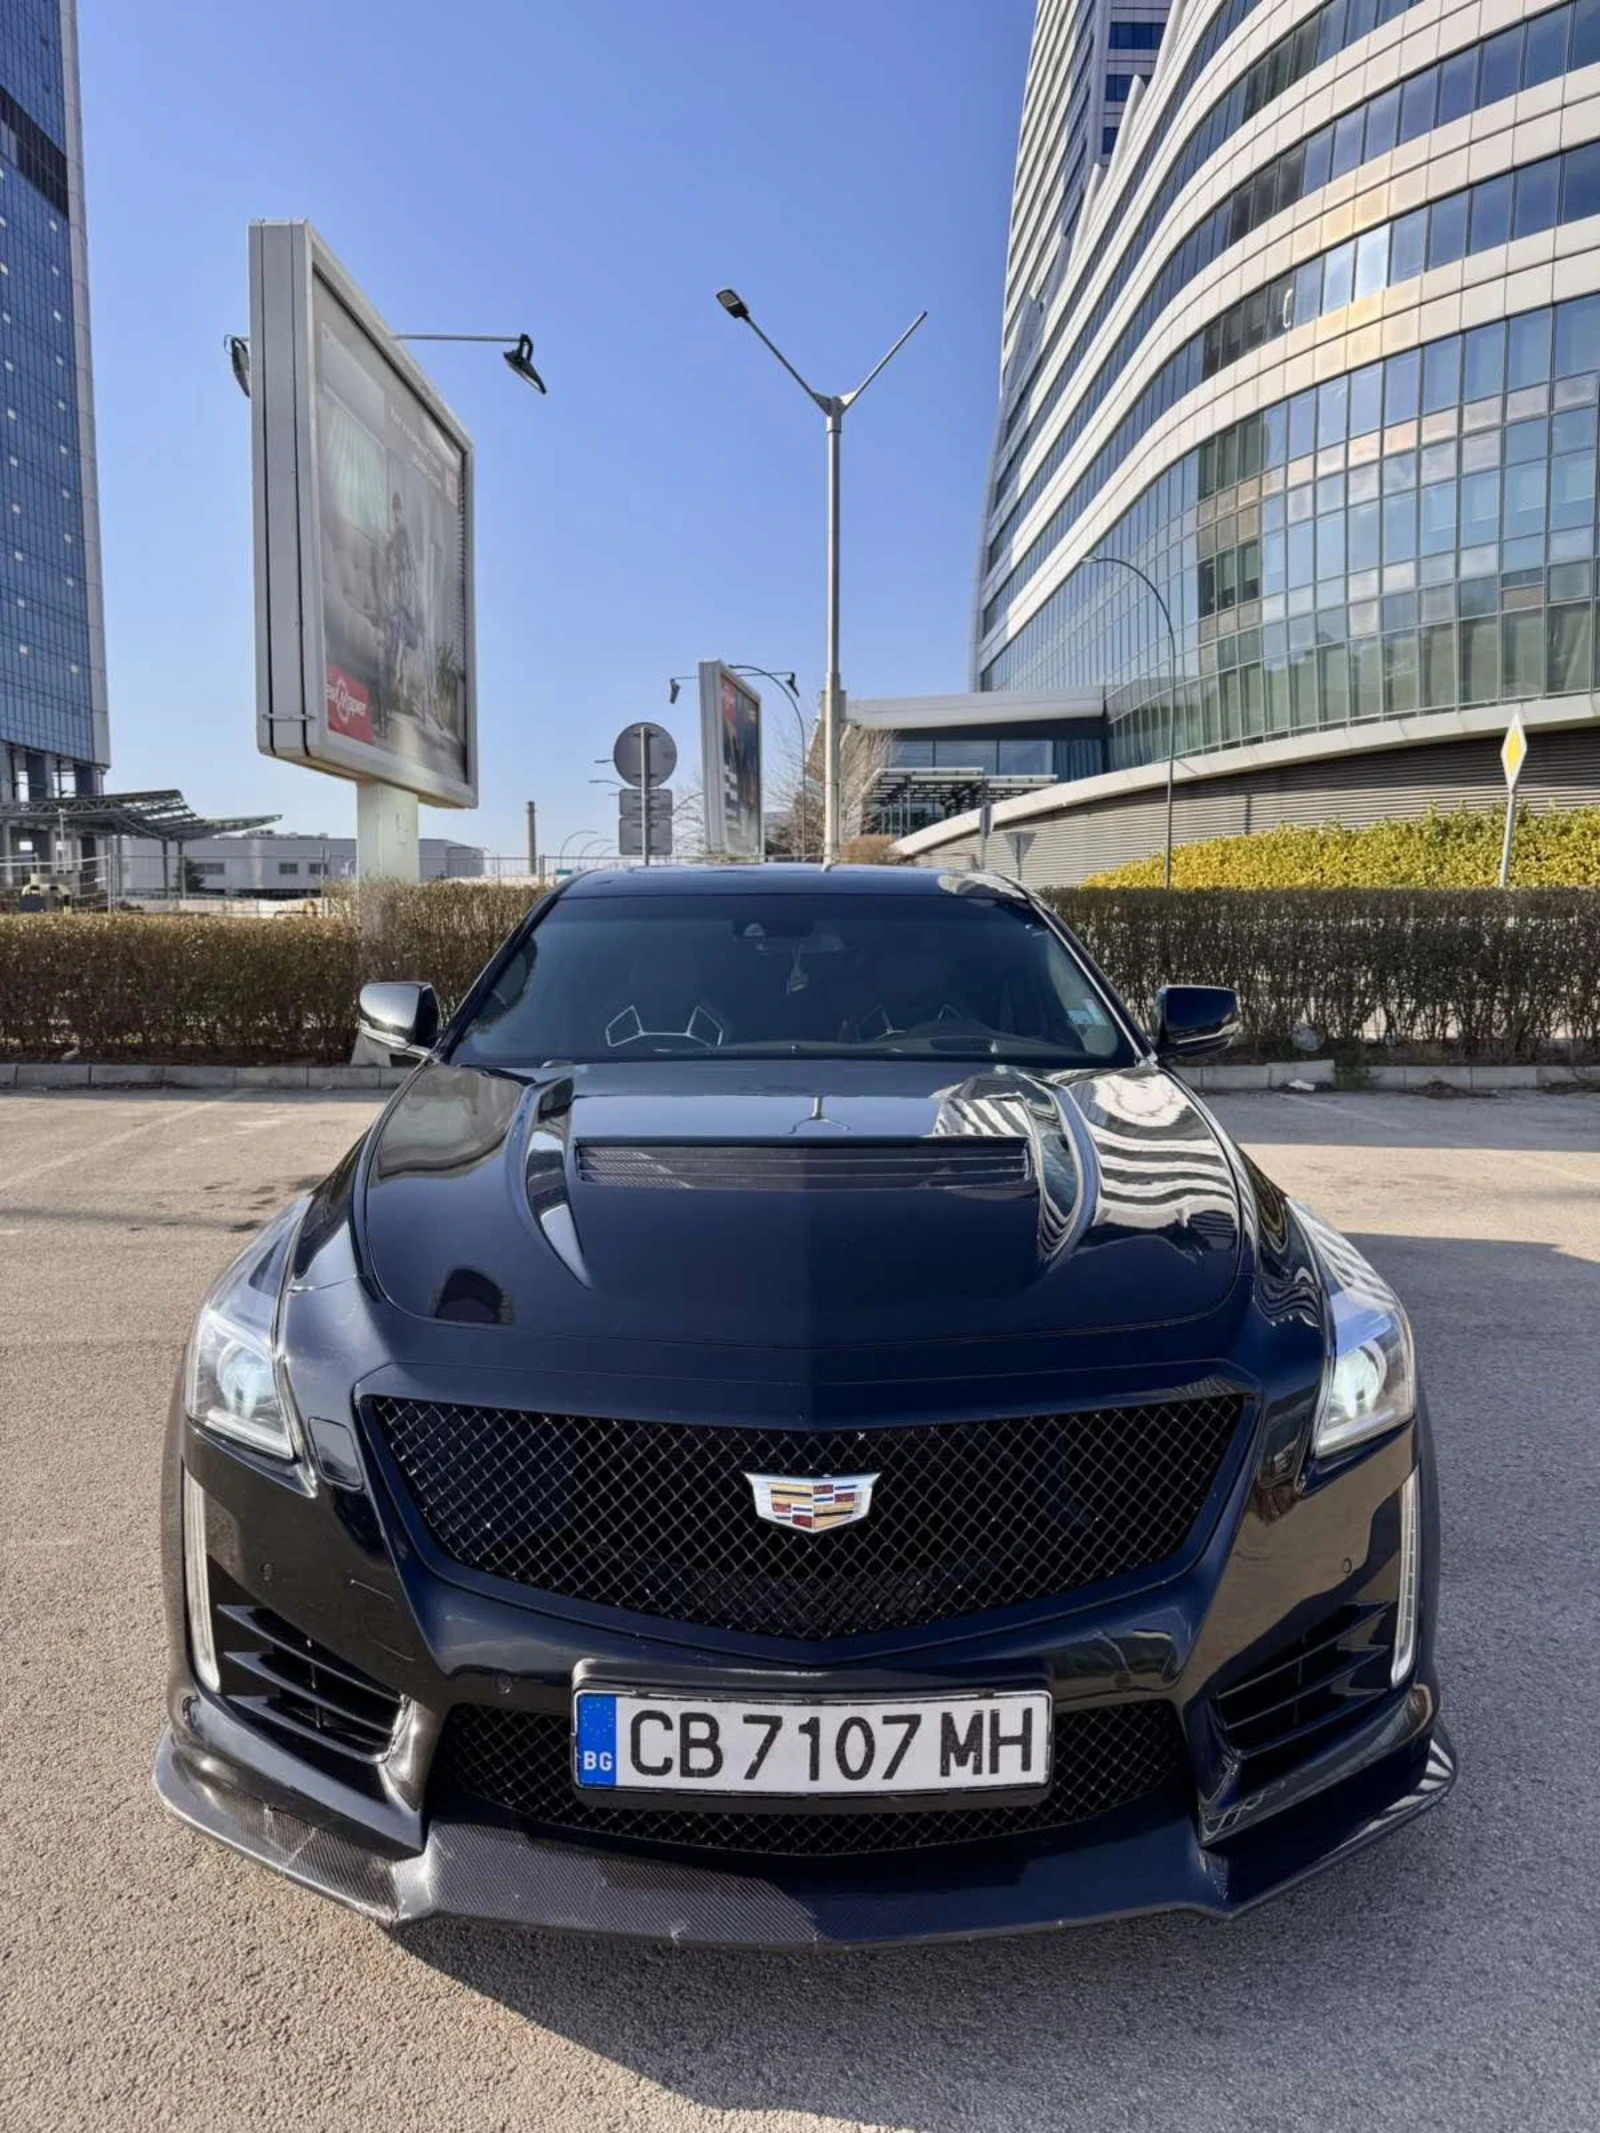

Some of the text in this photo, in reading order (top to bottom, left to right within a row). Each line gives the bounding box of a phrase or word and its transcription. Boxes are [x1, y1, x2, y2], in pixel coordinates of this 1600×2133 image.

[583, 1751, 613, 1771] BG
[630, 1707, 1032, 1781] CB 7107 MH
